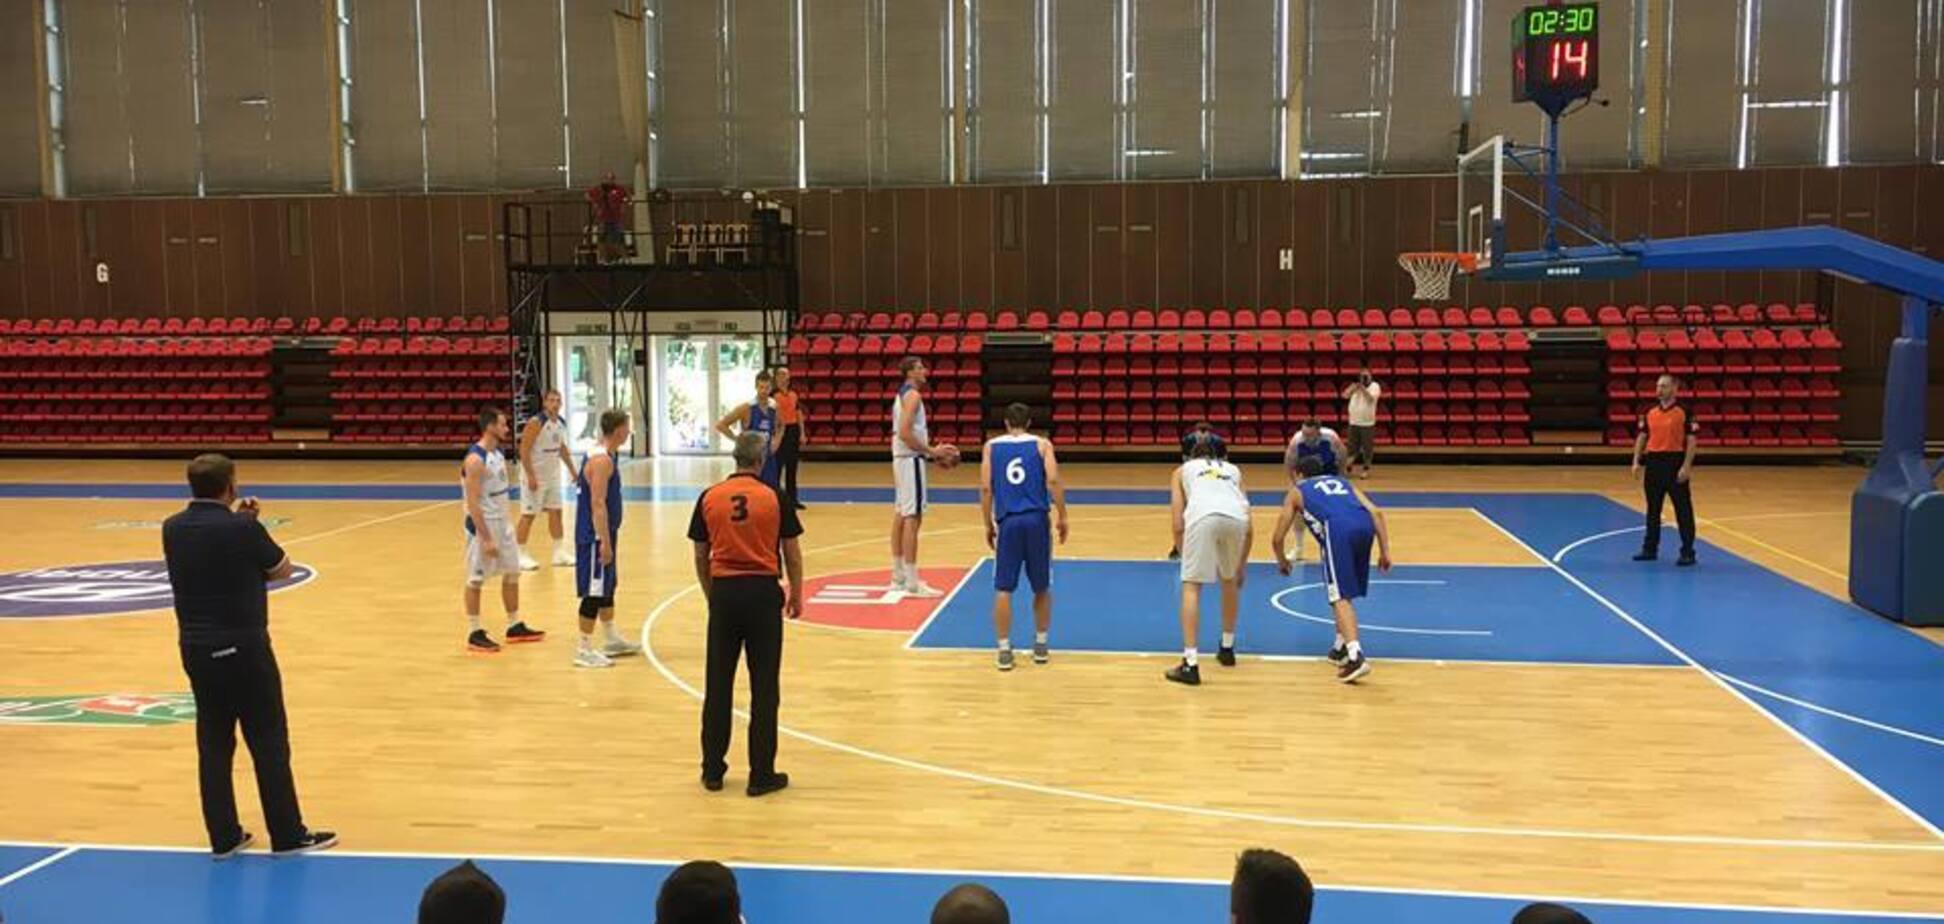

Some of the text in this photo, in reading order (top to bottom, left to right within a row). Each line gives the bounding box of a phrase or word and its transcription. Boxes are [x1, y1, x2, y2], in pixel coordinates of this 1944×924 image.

[1529, 8, 1594, 35] 02:30
[1551, 41, 1588, 80] 14
[96, 263, 108, 283] G
[1279, 249, 1293, 270] H
[1006, 456, 1026, 485] 6
[1313, 479, 1350, 495] 12
[730, 495, 748, 522] 3
